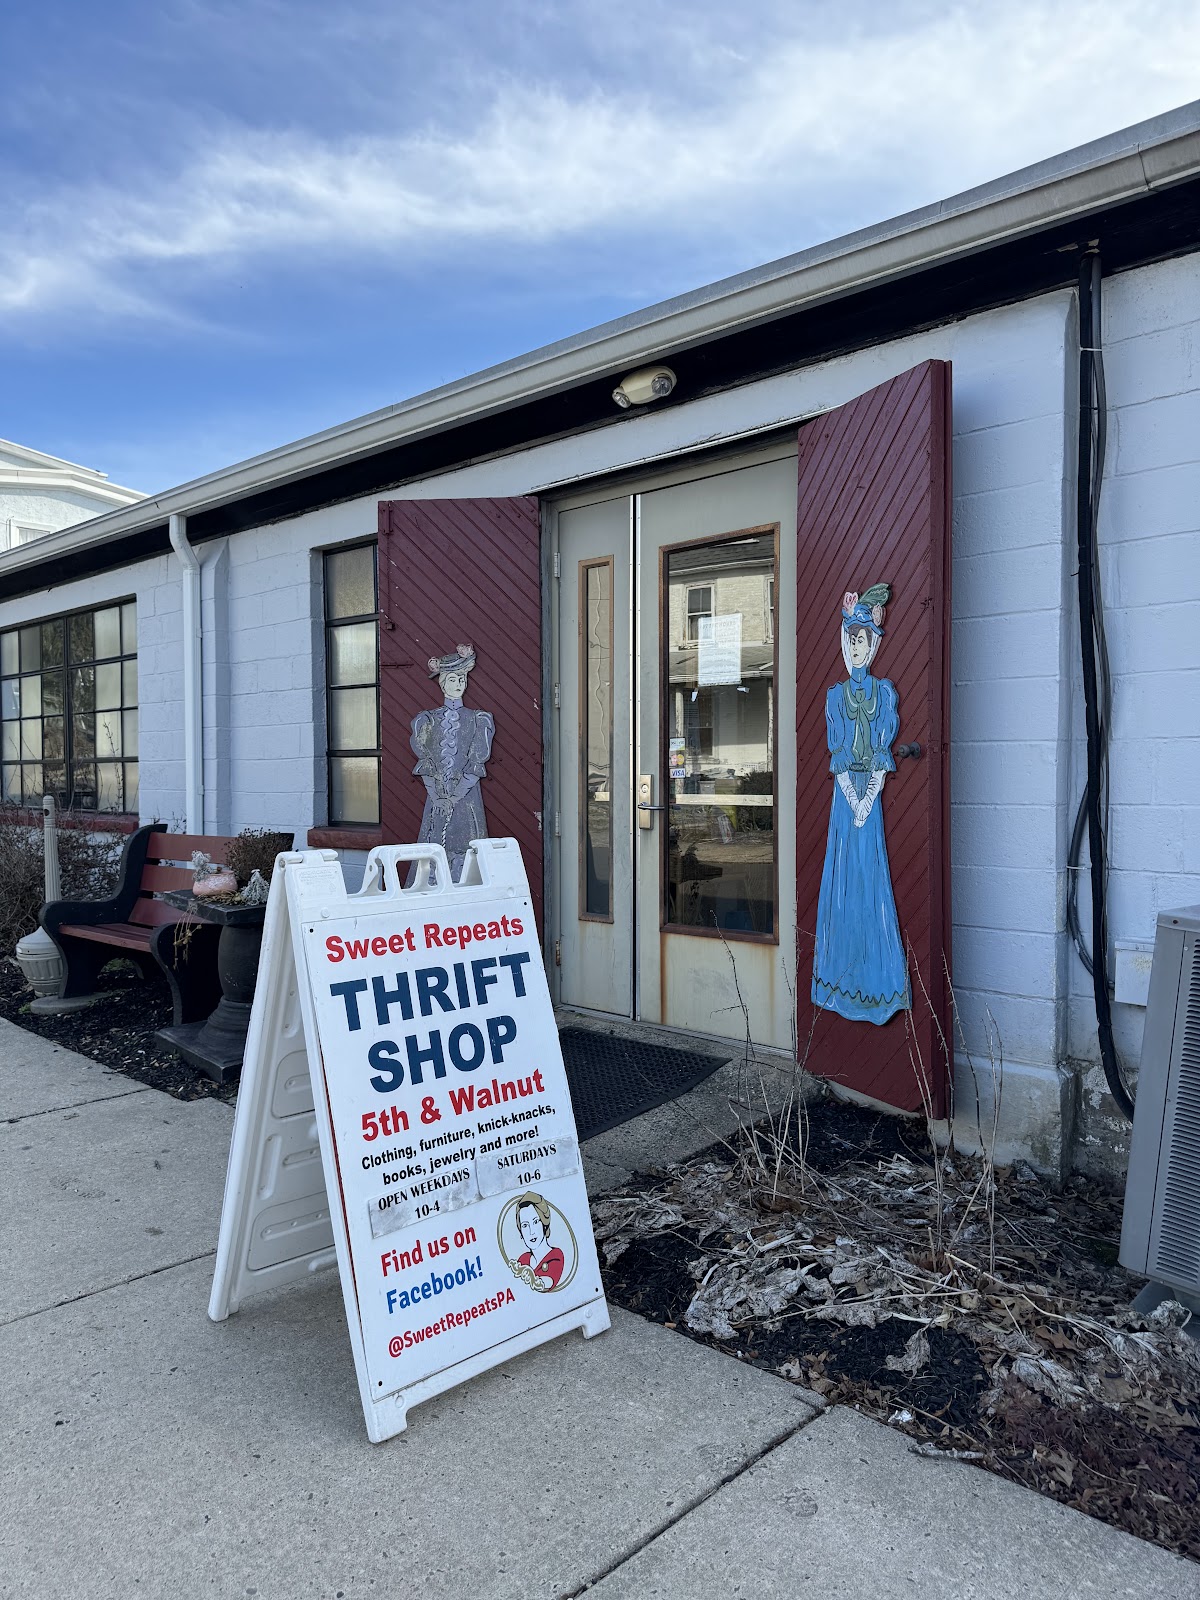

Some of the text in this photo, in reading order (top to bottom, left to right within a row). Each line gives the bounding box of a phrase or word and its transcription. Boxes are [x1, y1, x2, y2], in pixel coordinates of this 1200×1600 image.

[325, 915, 524, 963] Sweet Repeats
[330, 951, 531, 1032] THRIFT
[367, 1015, 517, 1093] SHOP
[361, 1068, 545, 1141] 5th & Walnut
[361, 1104, 556, 1170] Clothing, furniture, knick-knacks,
[382, 1125, 540, 1185] books, jewelry and more!
[497, 1143, 557, 1170] SATURDAYS
[378, 1167, 471, 1211] OPEN WEEKDAYS
[517, 1169, 542, 1186] 10-6
[415, 1201, 441, 1219] 10-4
[380, 1226, 477, 1277] Find us on
[386, 1255, 484, 1314] Facebook!
[388, 1287, 516, 1358] @SweetRepeatsPA
